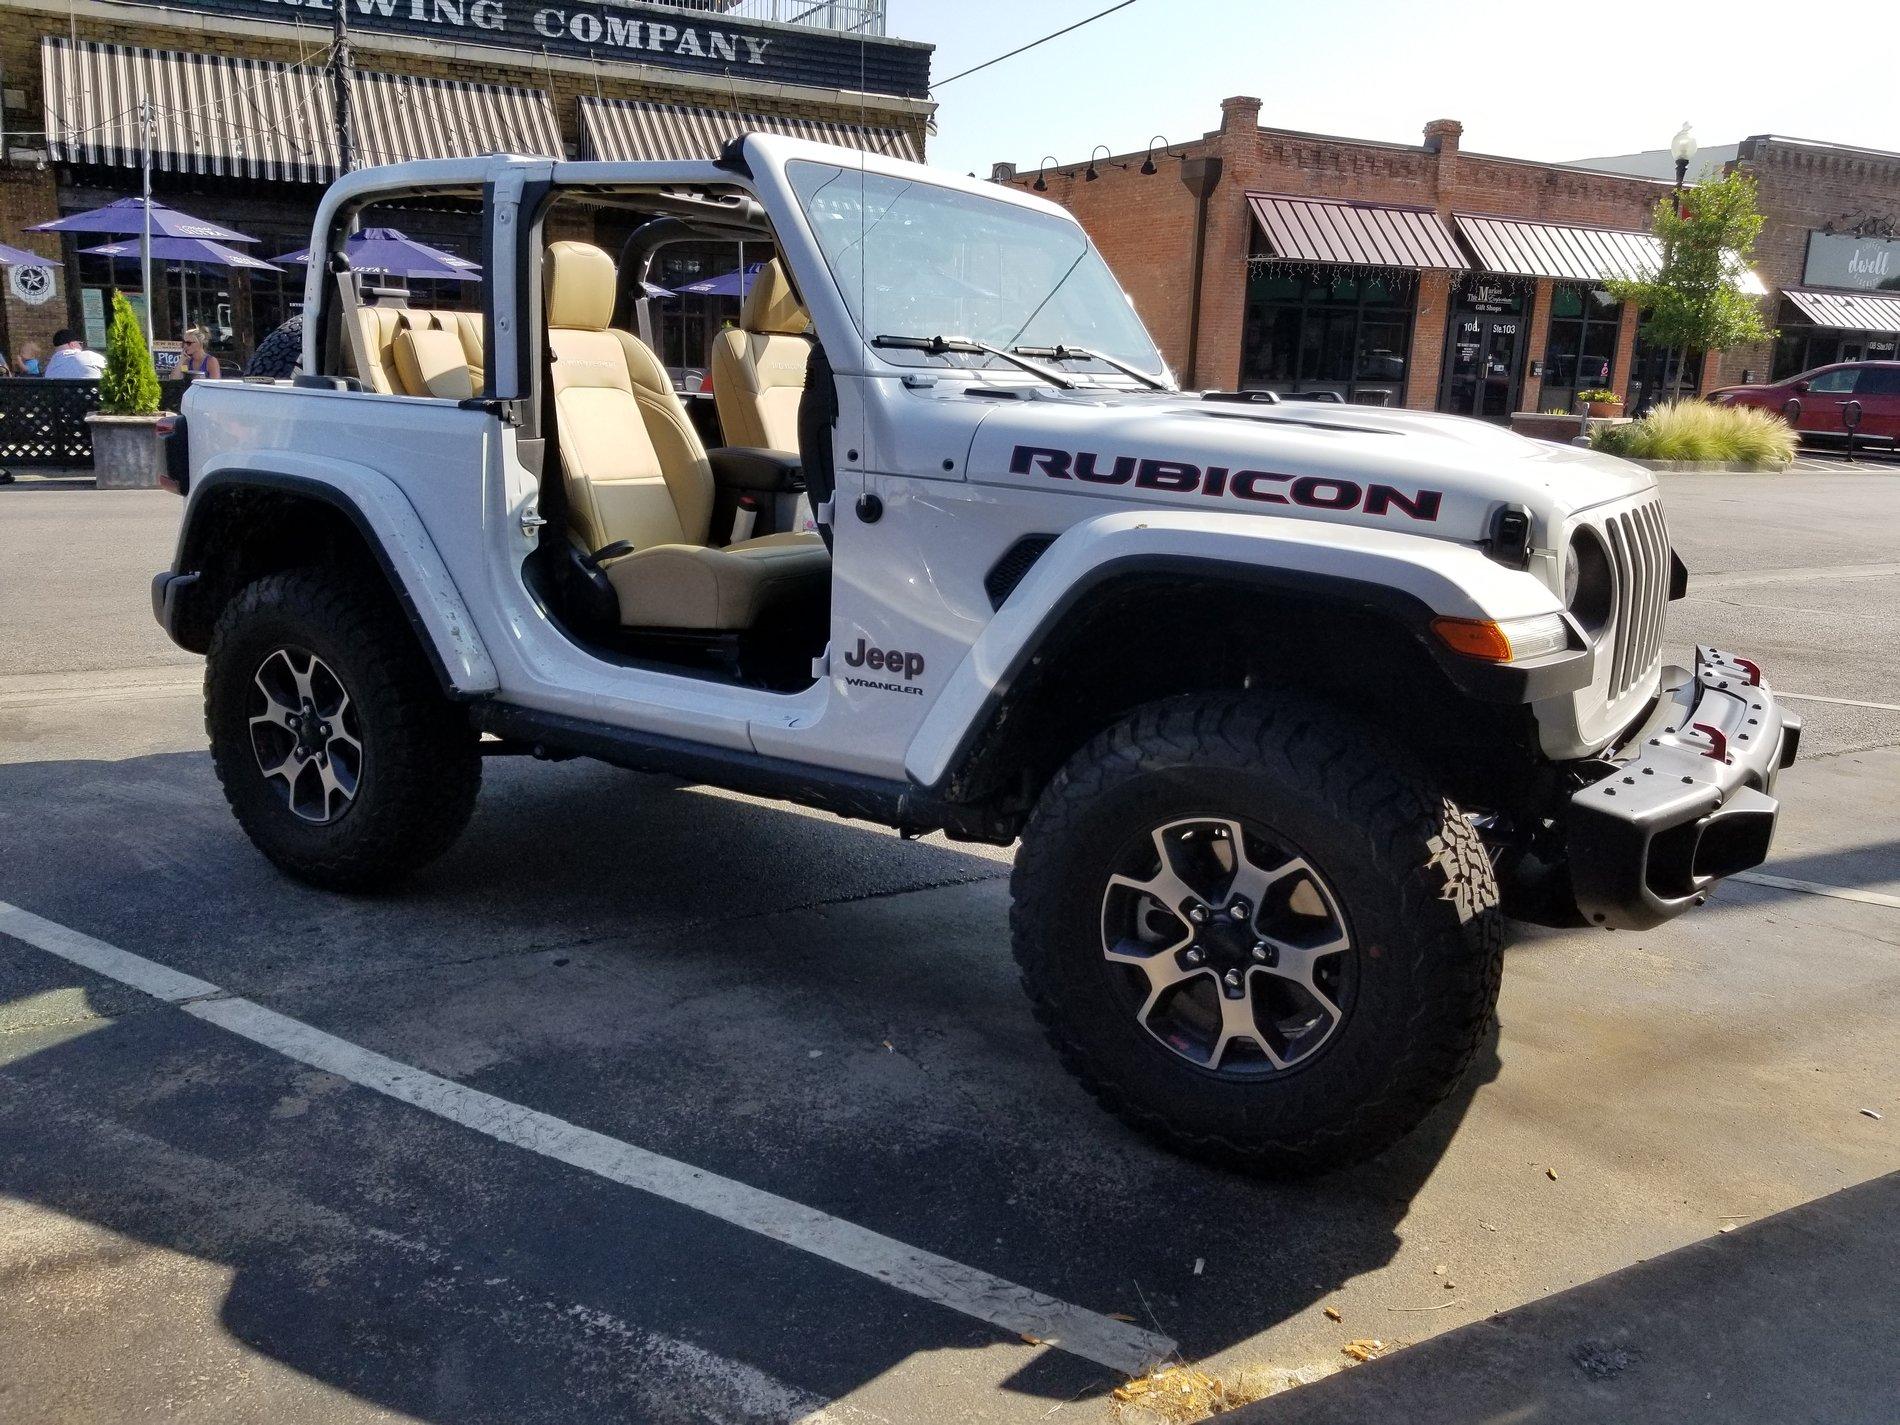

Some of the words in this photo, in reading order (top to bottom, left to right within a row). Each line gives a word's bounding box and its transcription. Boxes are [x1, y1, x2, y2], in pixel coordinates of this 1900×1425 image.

[264, 0, 507, 31] WING
[533, 8, 773, 65] COMPANY
[1848, 249, 1889, 275] dwell
[1467, 293, 1478, 302] The
[1478, 286, 1502, 302] Market
[1486, 304, 1502, 313] Shops
[1008, 444, 1443, 522] RUBICON
[844, 638, 925, 681] Jeep
[845, 676, 924, 696] WRANGLER
